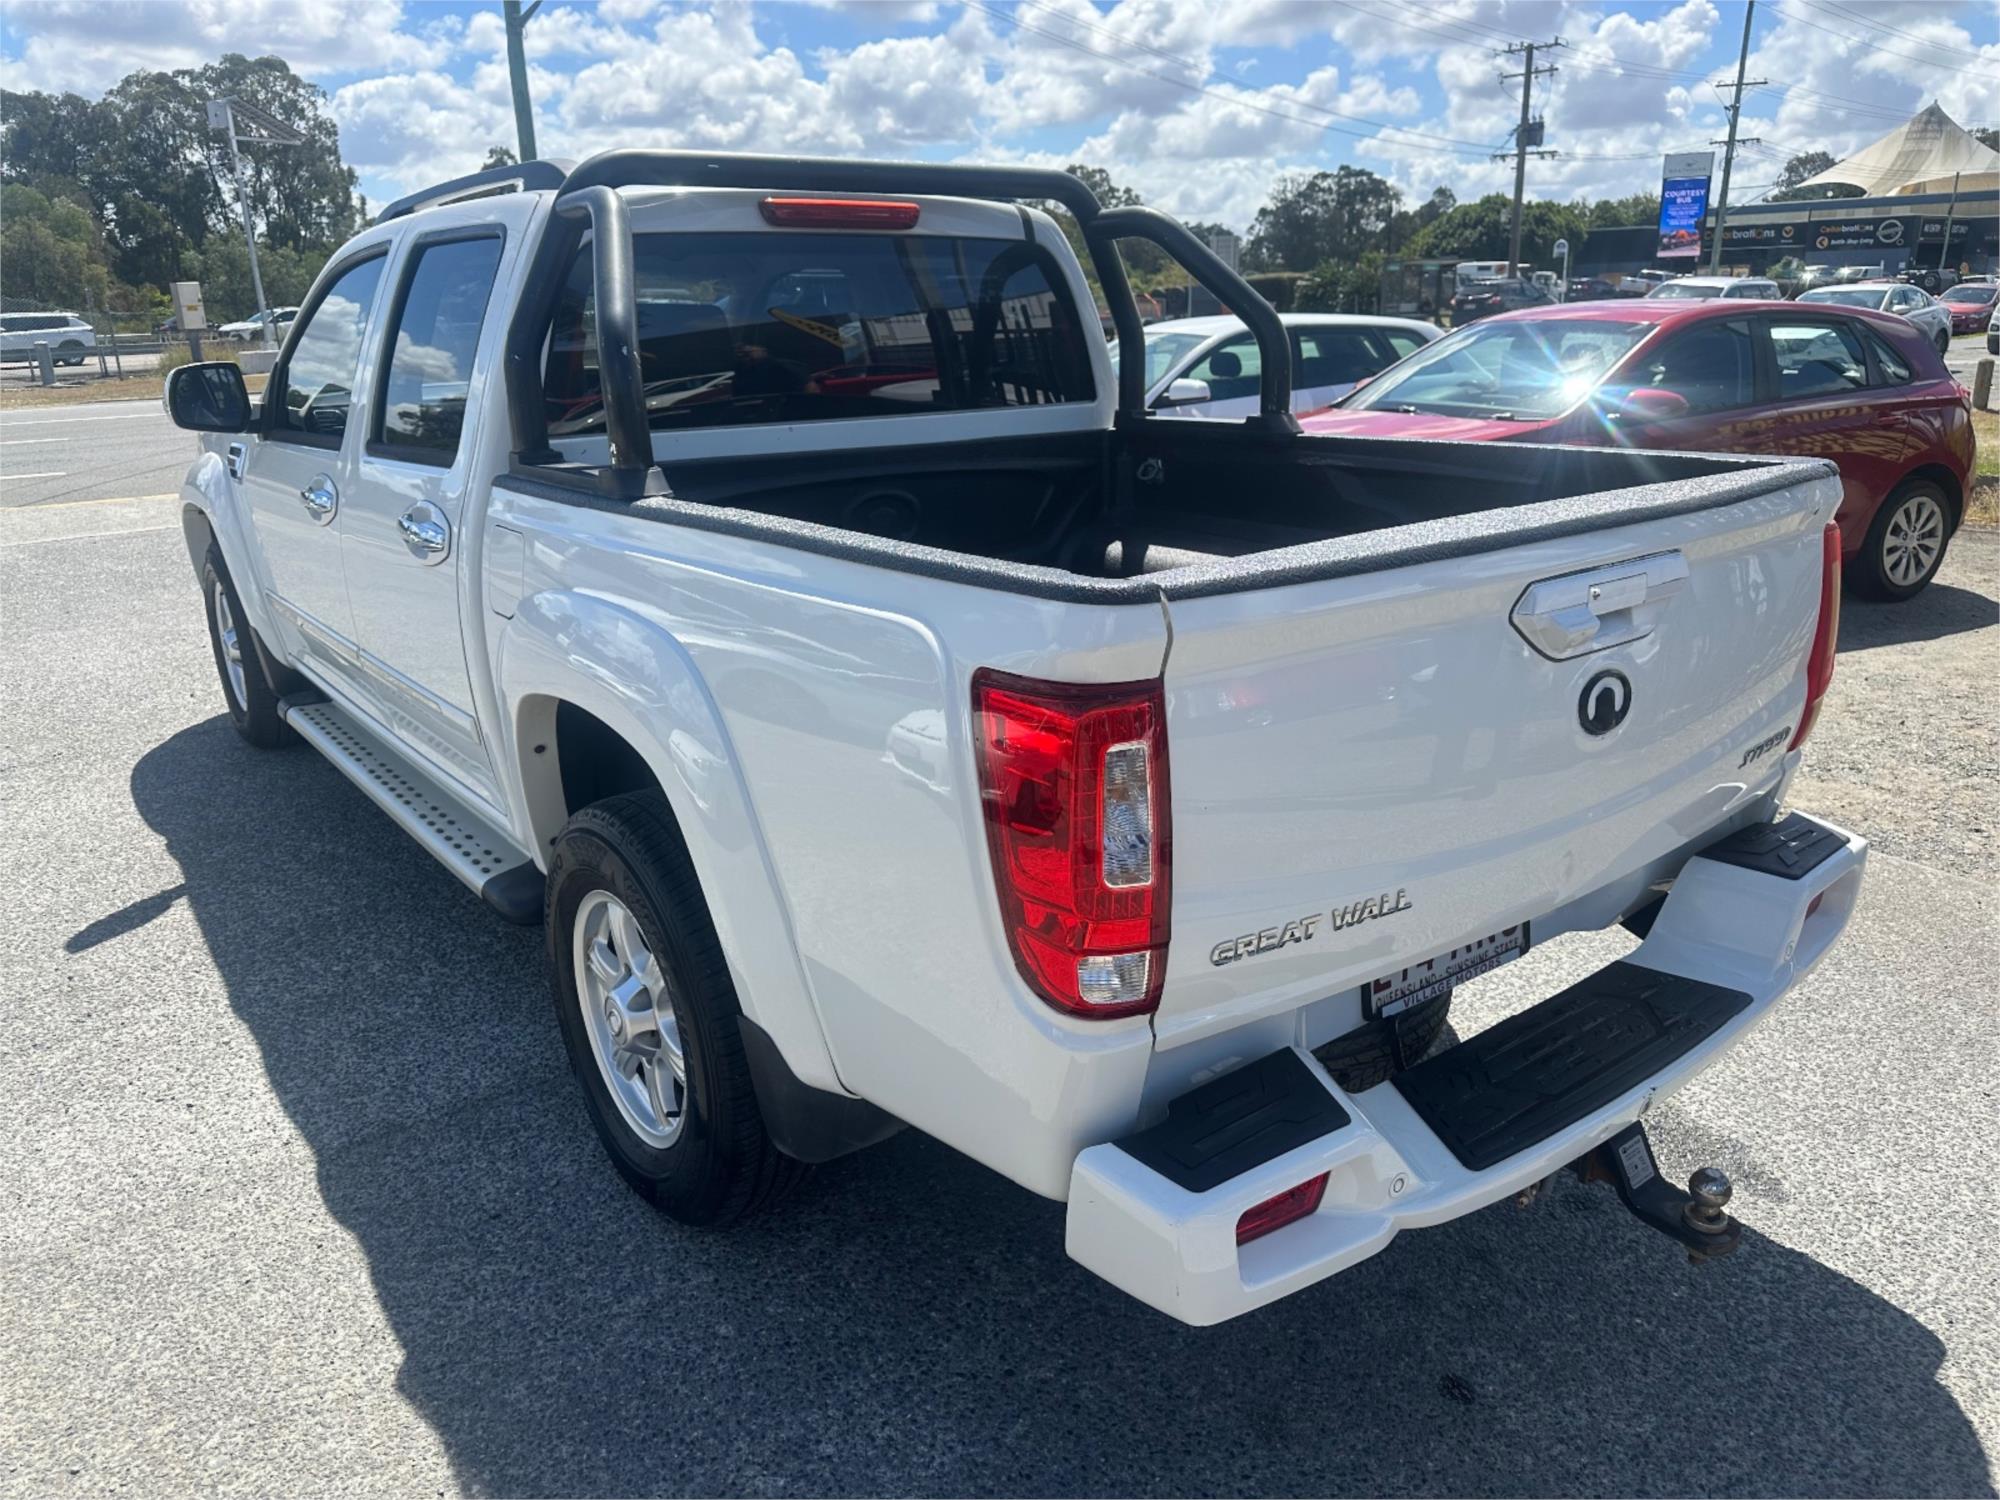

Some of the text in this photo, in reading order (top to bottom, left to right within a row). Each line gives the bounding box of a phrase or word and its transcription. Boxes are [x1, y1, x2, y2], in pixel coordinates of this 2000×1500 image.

[1664, 189, 1706, 198] COURTESY
[1676, 196, 1692, 204] BUS
[1210, 913, 1323, 967] GREAT
[1331, 888, 1413, 932] WALL
[1375, 972, 1437, 1007] QUEENSLAND
[1445, 949, 1490, 979] SUNSHINE
[1490, 936, 1520, 959] STATE
[1402, 980, 1453, 1009] VILLAGE
[1454, 958, 1501, 985] MOTORS
